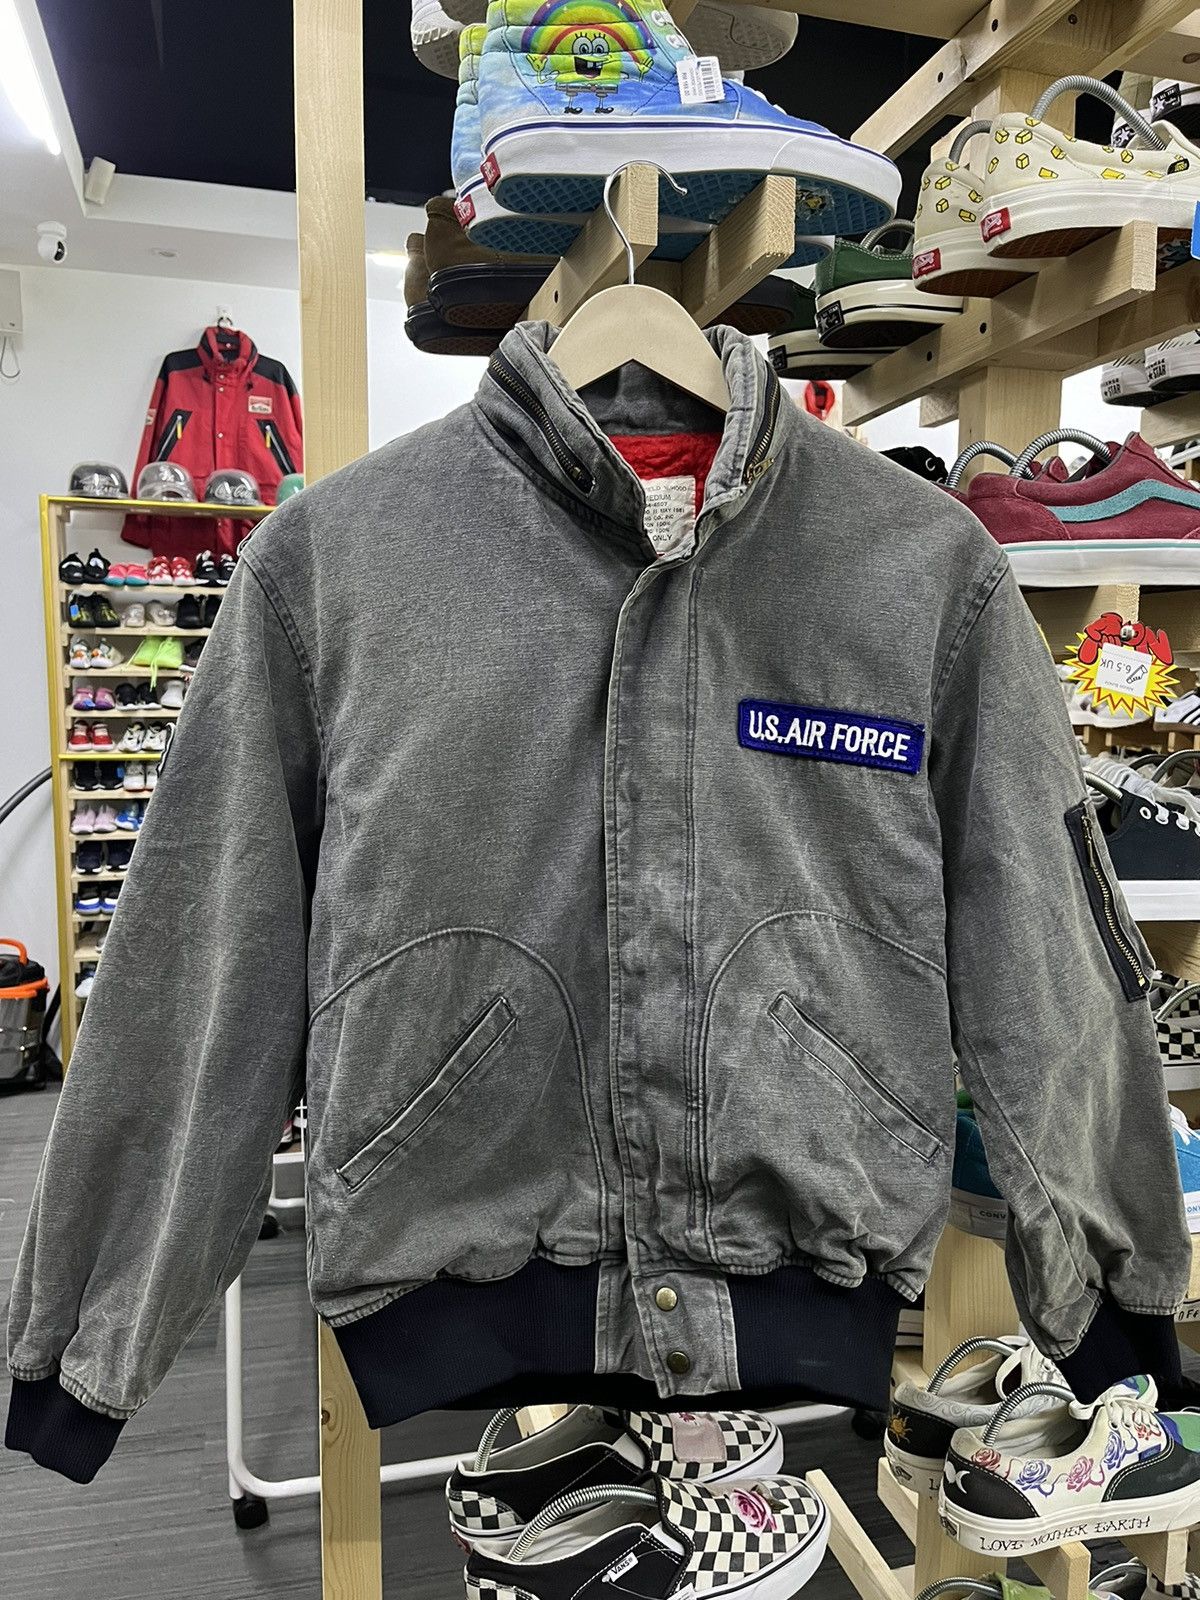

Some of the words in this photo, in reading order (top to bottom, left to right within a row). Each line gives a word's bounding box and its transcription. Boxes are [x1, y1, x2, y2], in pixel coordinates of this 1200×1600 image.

[1100, 658, 1114, 670] UK
[1116, 662, 1132, 674] 6.5
[830, 722, 912, 762] FORCE
[979, 1536, 1024, 1551] LOVE
[1030, 1523, 1089, 1548] MOTHER
[1094, 1515, 1151, 1534] EARTH
